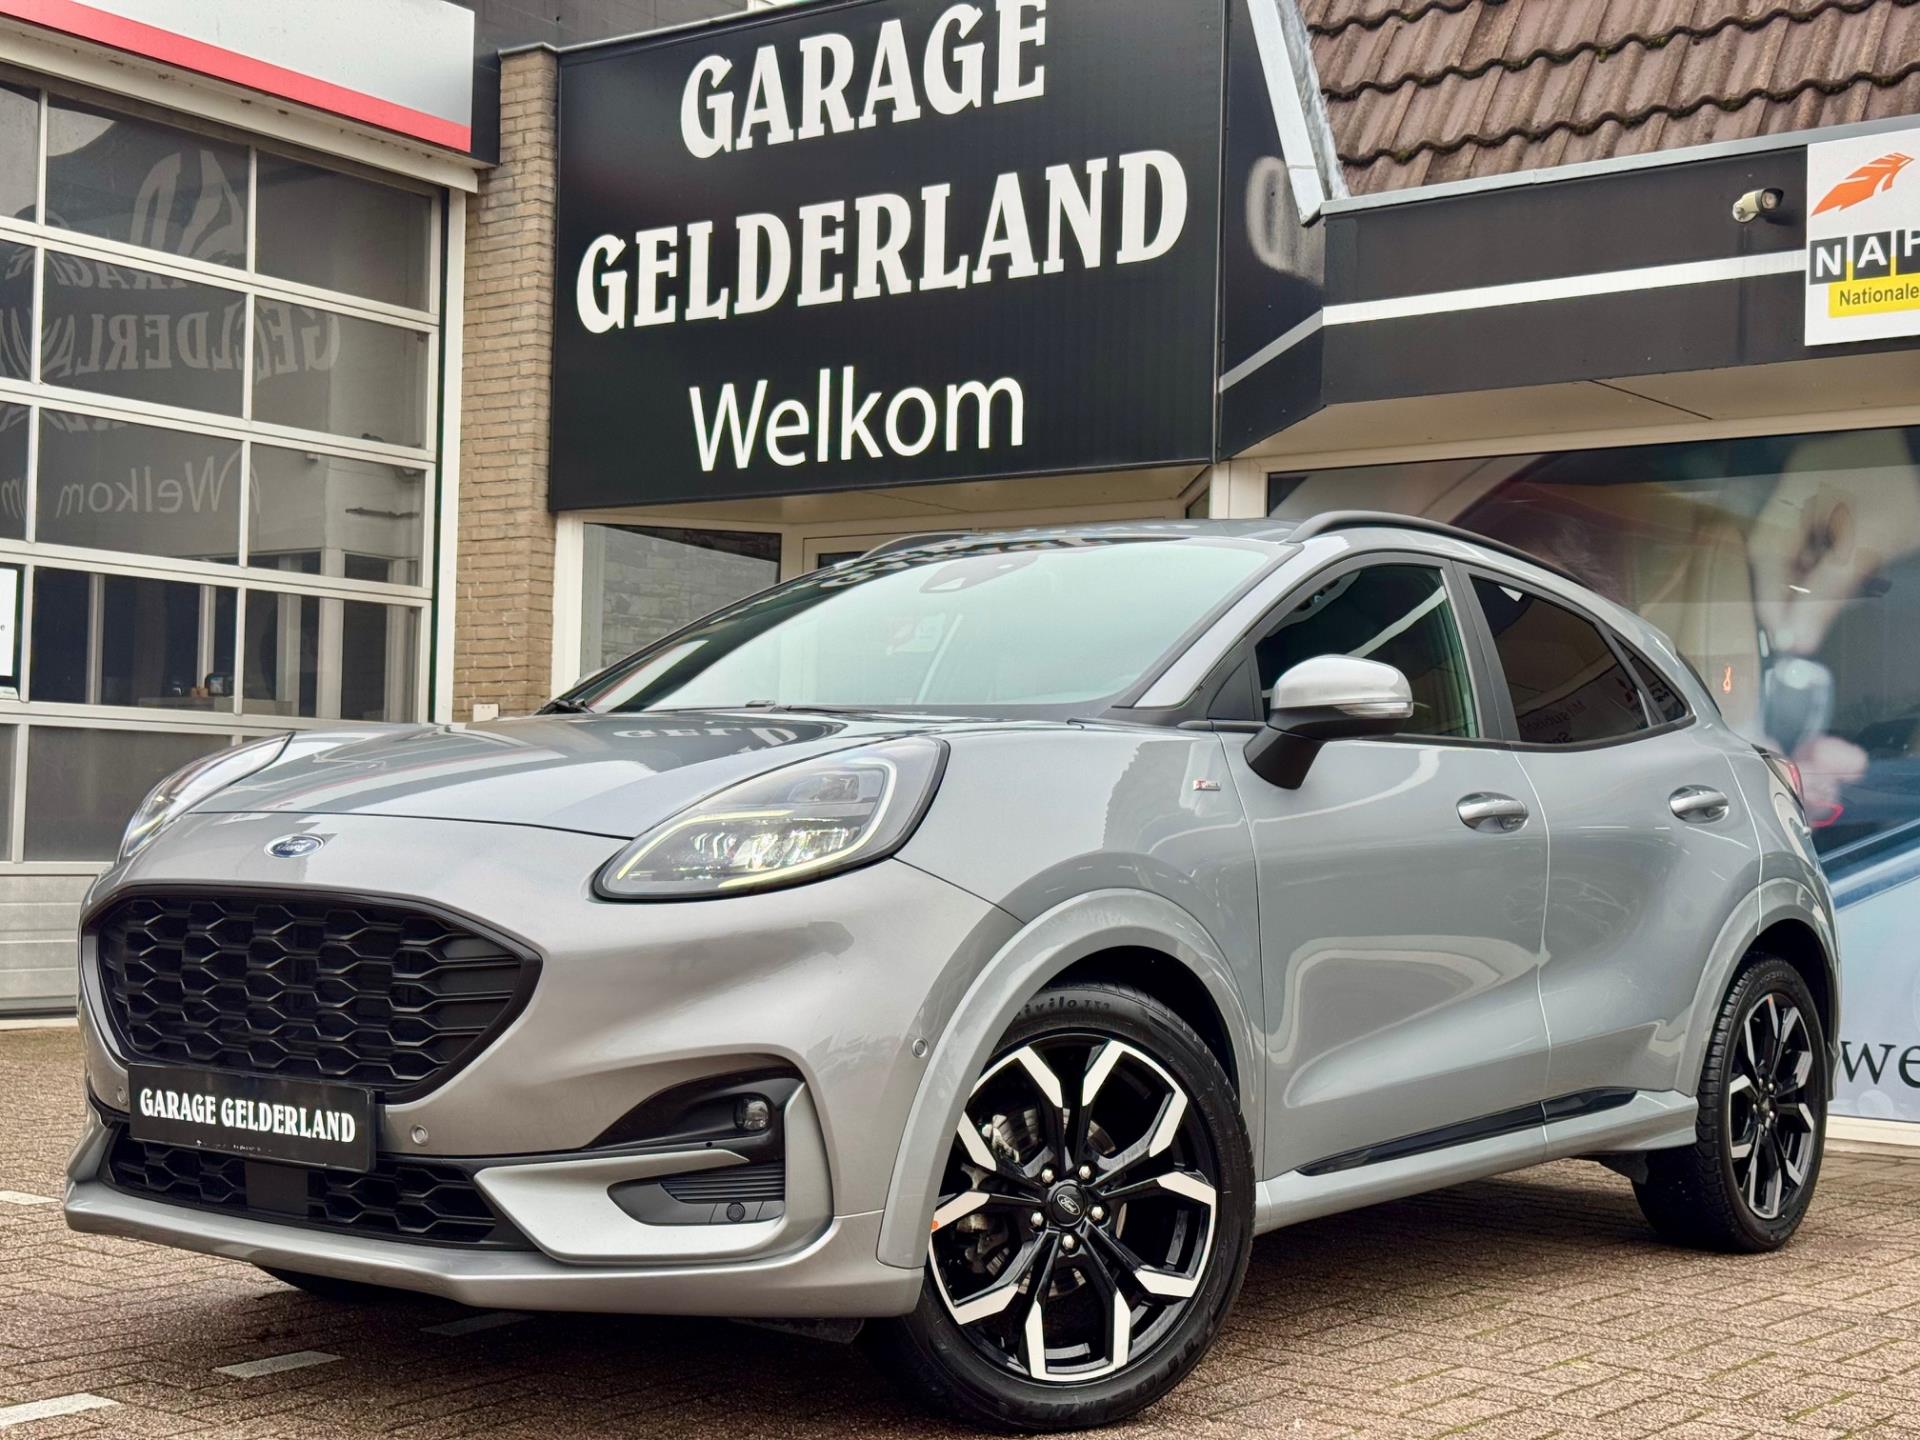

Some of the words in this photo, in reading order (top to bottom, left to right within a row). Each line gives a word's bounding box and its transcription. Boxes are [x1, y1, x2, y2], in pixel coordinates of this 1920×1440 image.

[681, 0, 1046, 158] GARAGE
[577, 150, 1187, 333] GELDERLAND
[1839, 283, 1920, 306] Nationale
[690, 366, 1023, 471] Welkom
[139, 1087, 217, 1125] GARAGE
[220, 1097, 356, 1143] GELDERLAND
